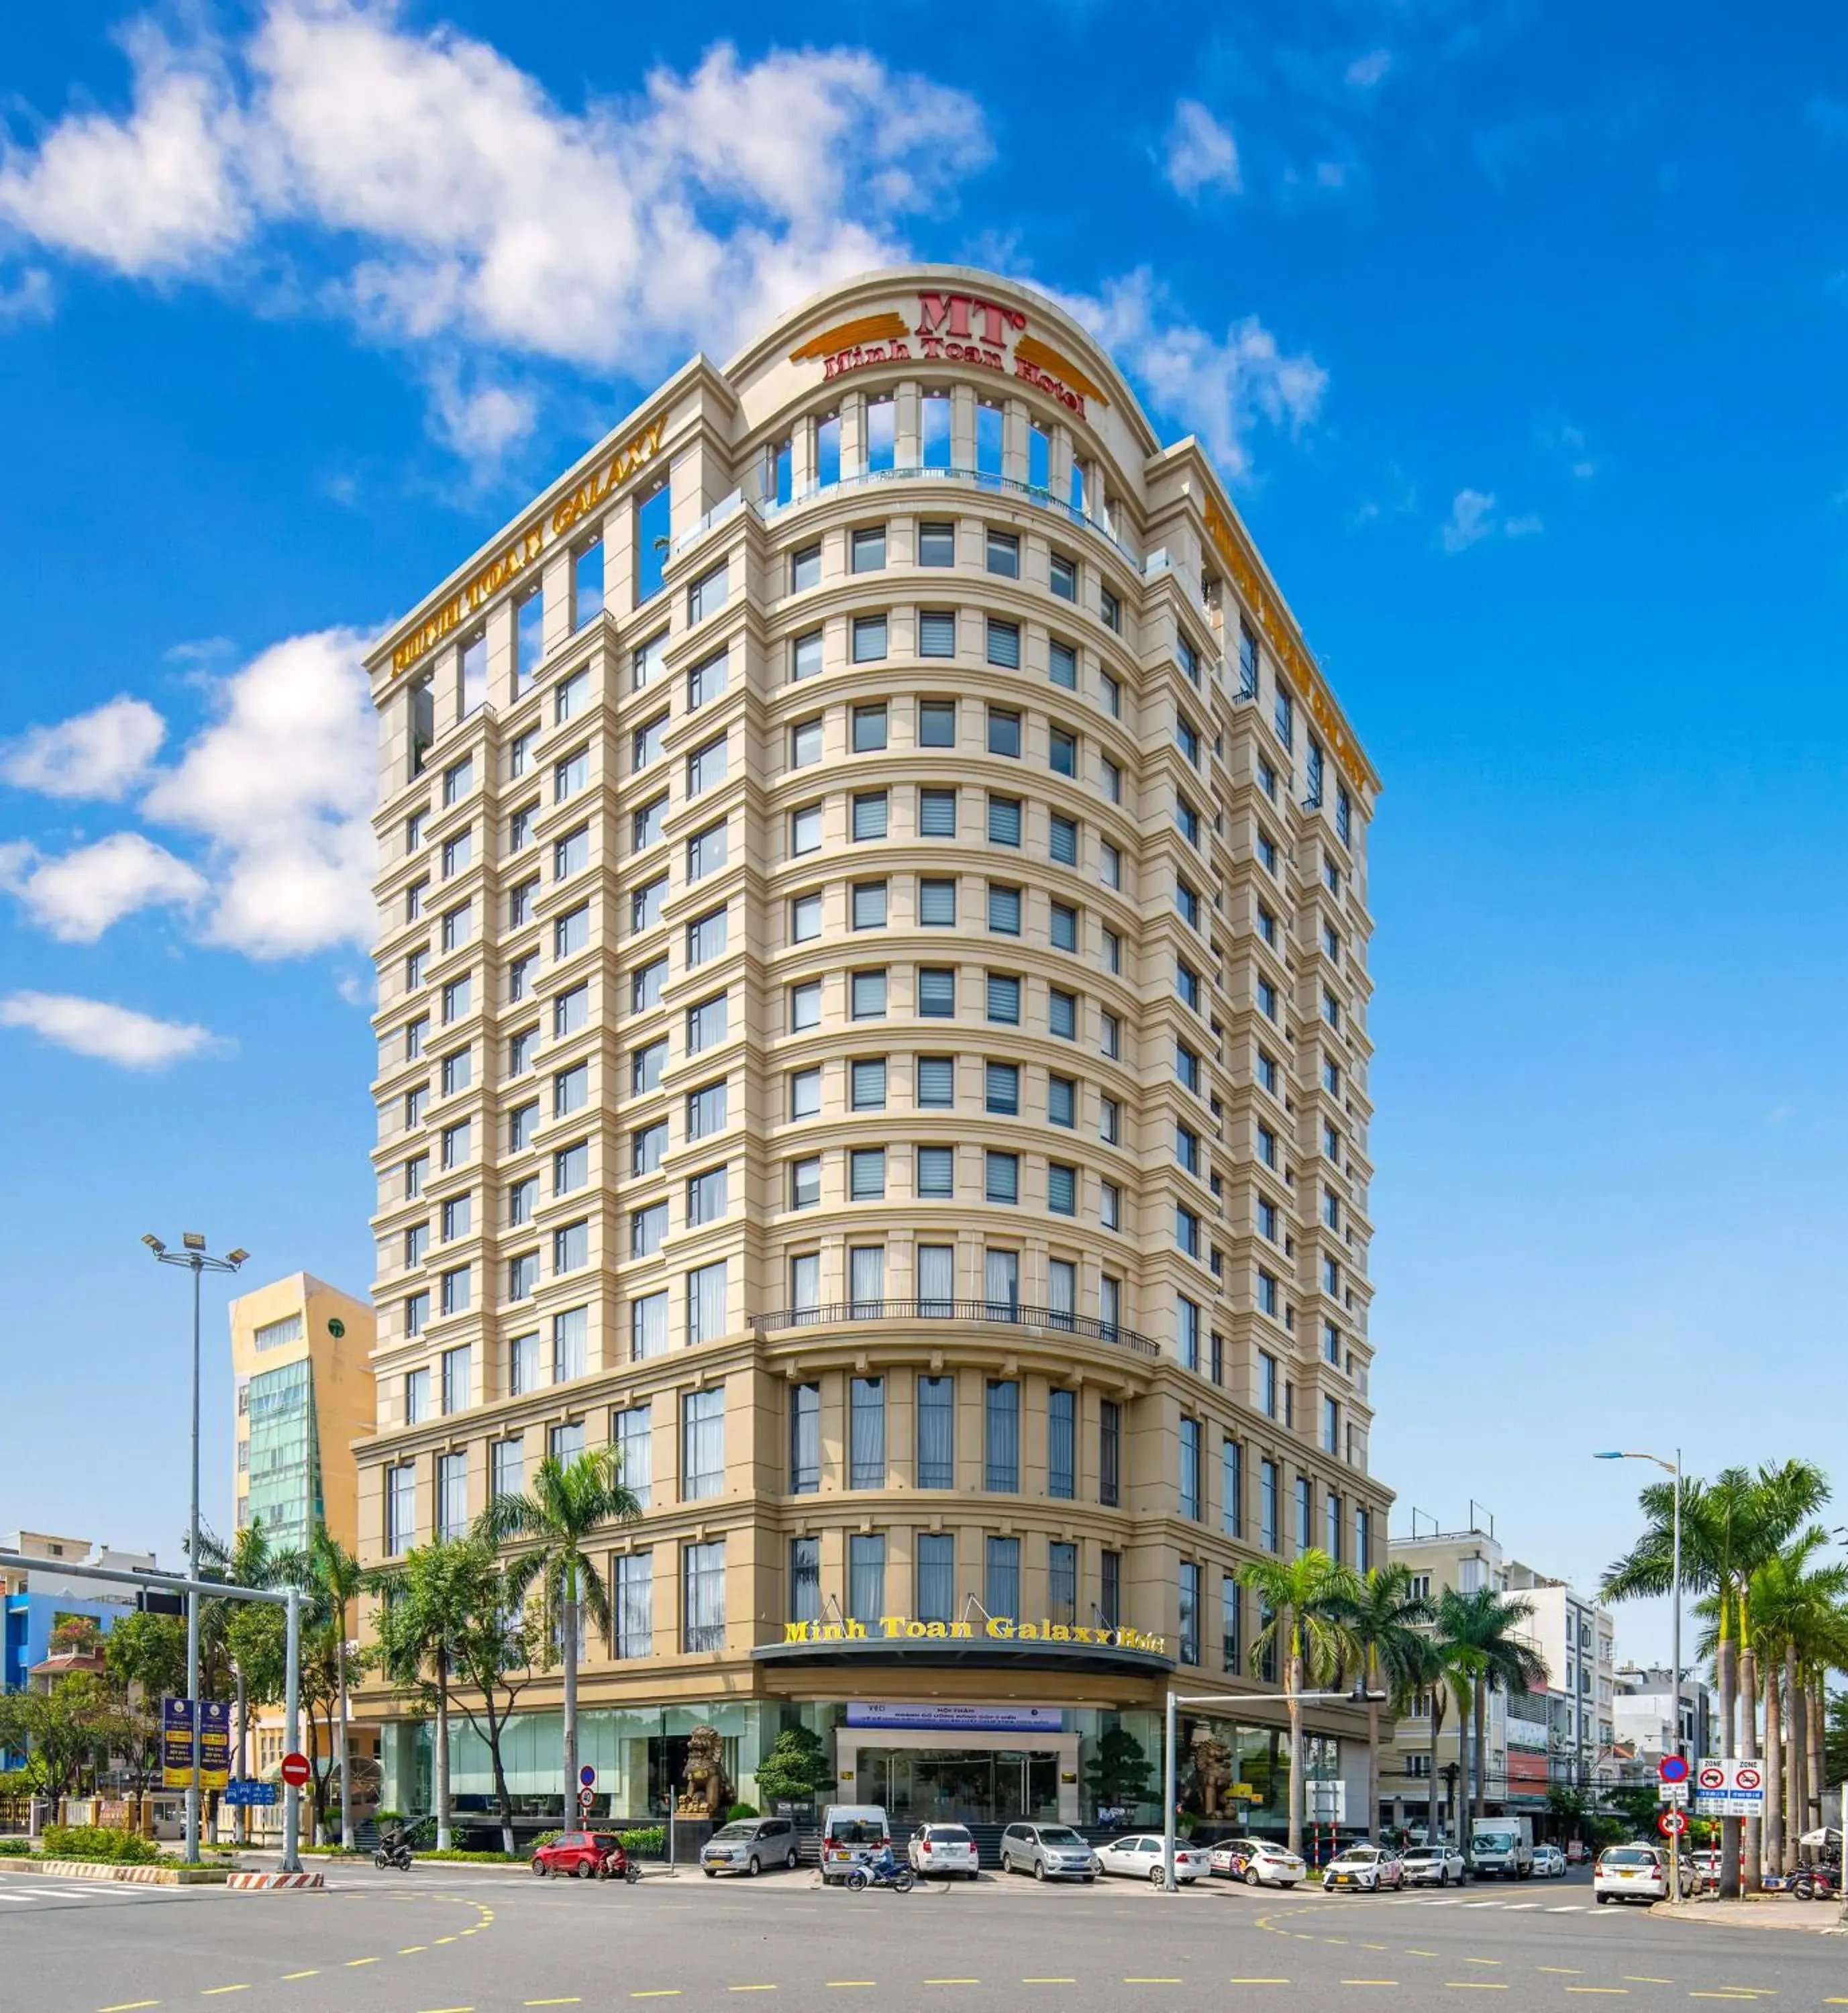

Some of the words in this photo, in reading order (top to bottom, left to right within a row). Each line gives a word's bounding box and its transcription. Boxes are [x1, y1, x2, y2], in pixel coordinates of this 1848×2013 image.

[823, 339, 911, 382] Minh
[920, 338, 1005, 372] Toan
[1014, 355, 1087, 421] Hotel
[552, 413, 668, 535] GALAXY
[784, 1618, 867, 1643] Minh
[879, 1616, 974, 1638] Toan
[986, 1616, 1112, 1644] Galaxy
